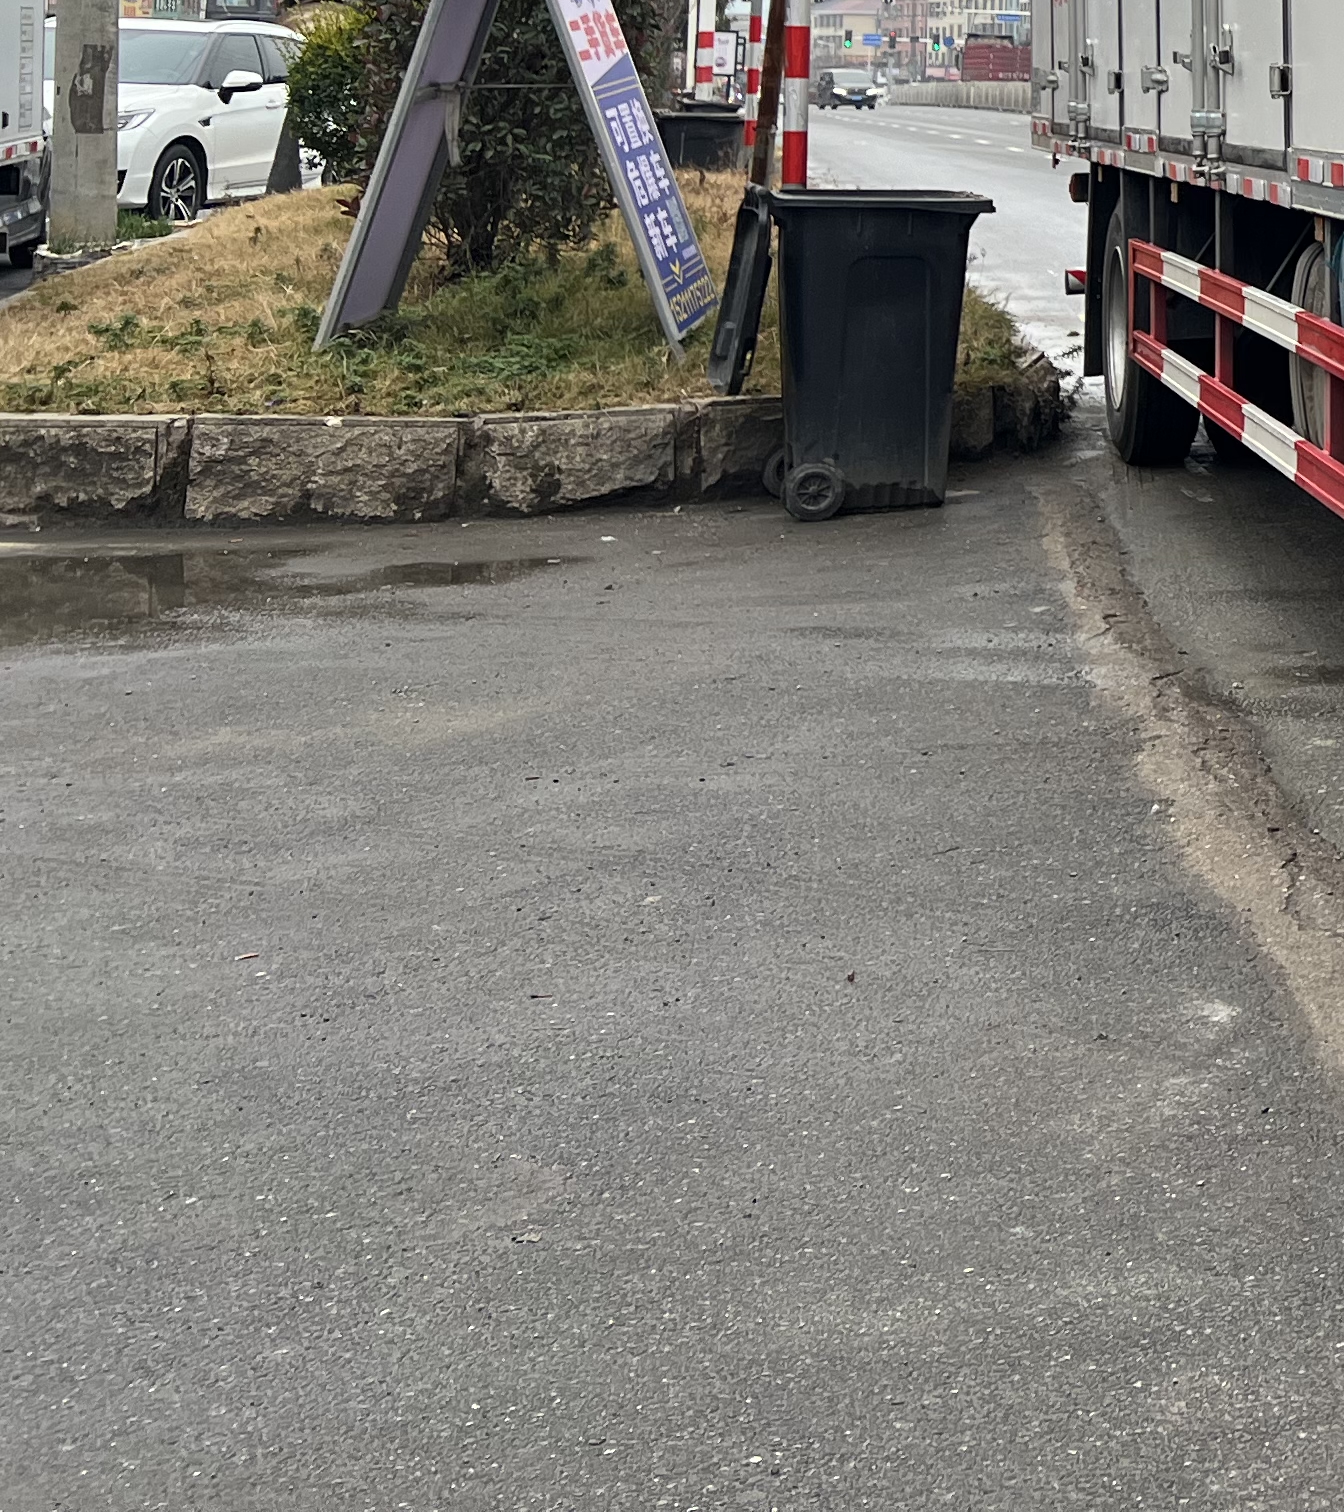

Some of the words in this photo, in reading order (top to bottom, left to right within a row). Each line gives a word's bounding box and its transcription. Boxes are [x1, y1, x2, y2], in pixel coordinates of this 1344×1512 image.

[569, 9, 626, 61] 二手货车
[605, 98, 654, 153] 可置换
